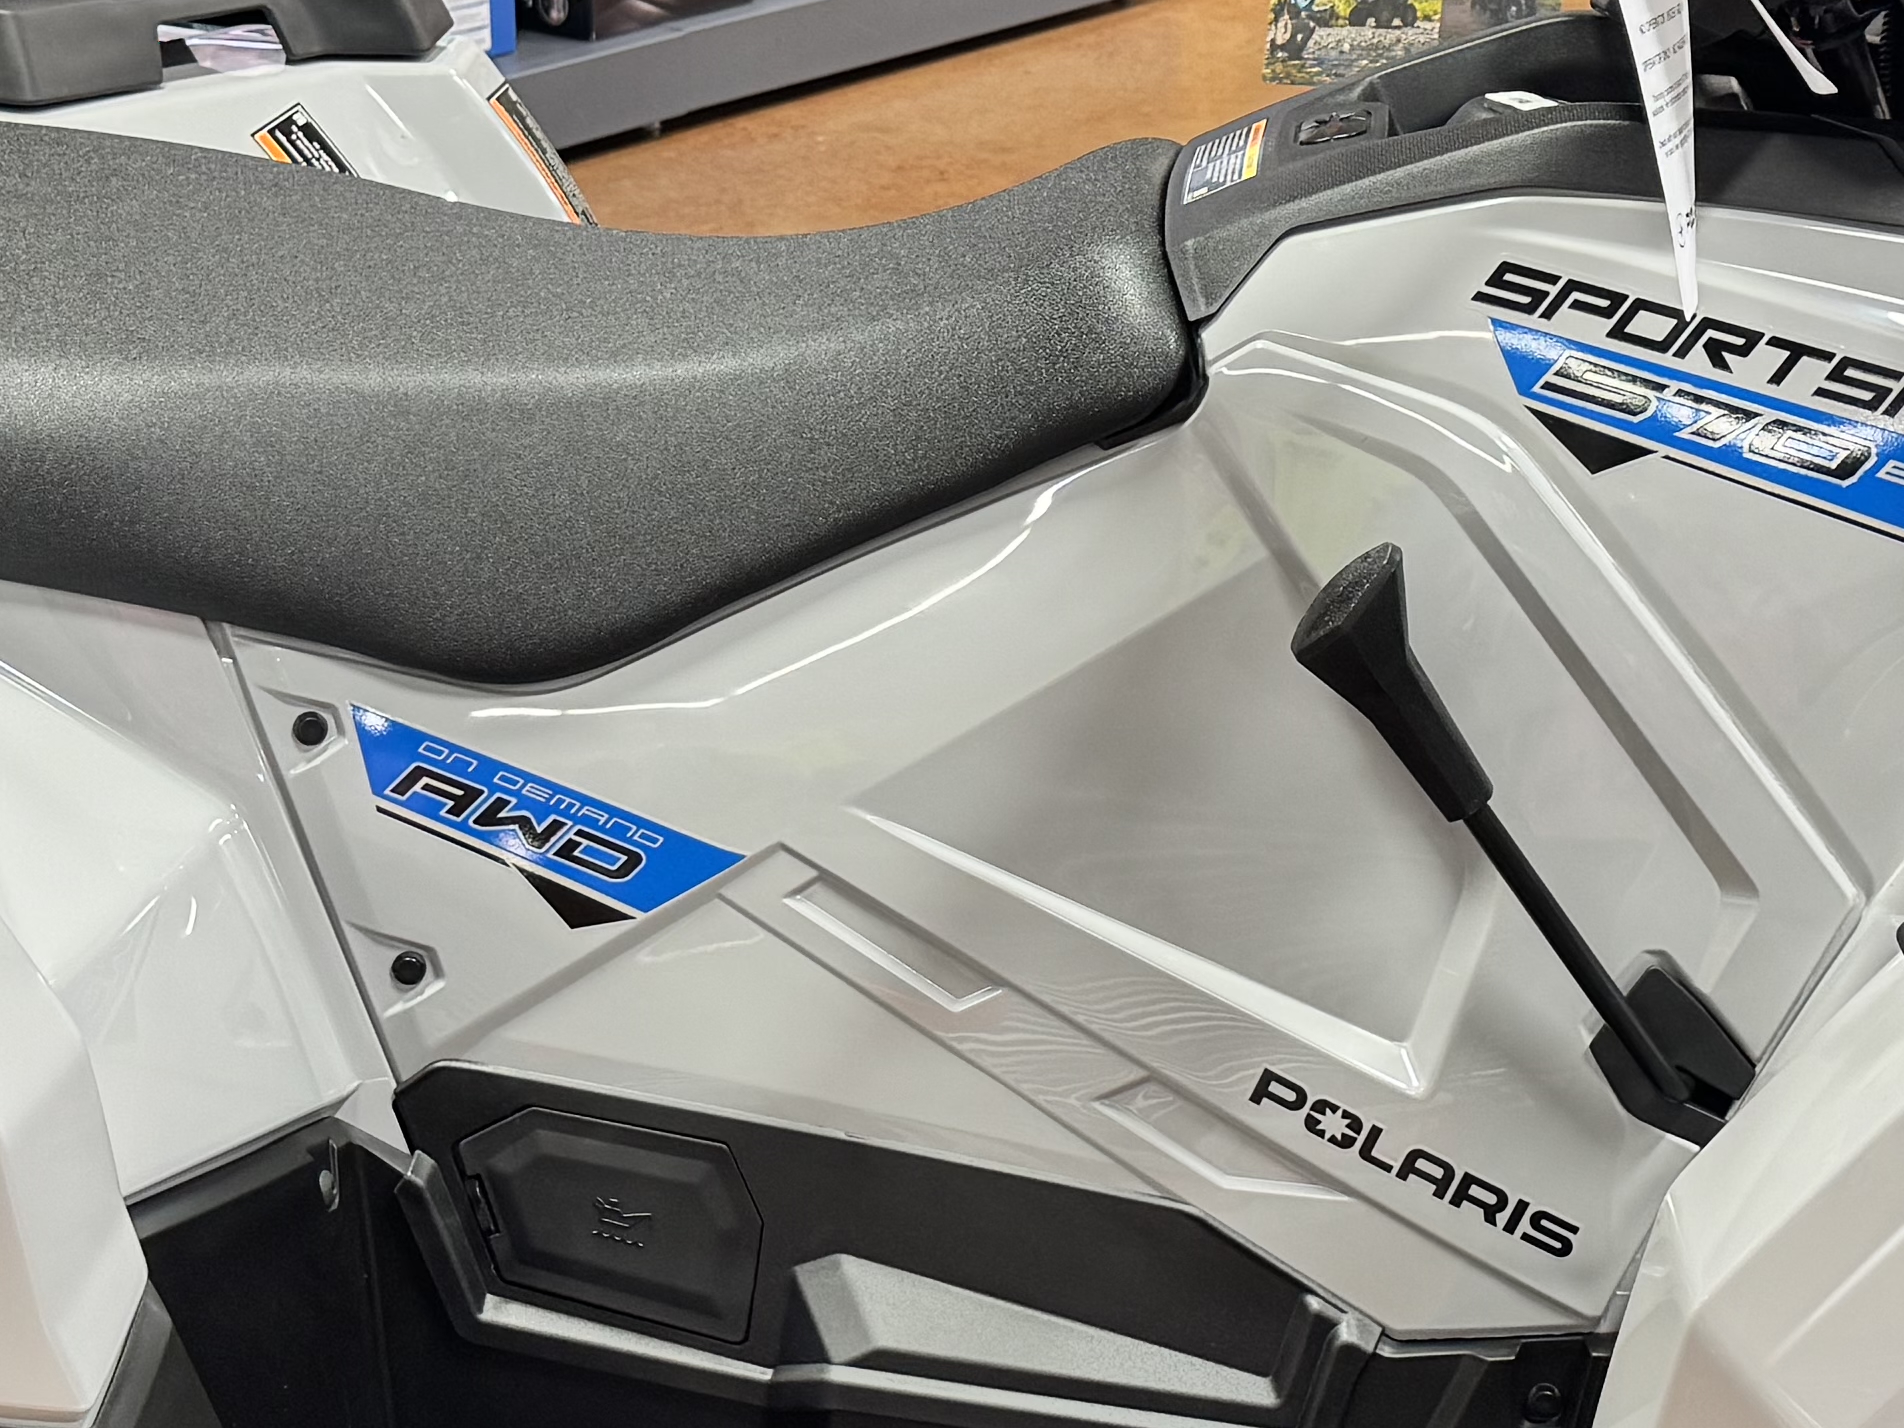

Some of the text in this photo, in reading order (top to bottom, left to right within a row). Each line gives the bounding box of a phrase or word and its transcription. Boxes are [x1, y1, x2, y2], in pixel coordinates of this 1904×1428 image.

[1532, 349, 1878, 486] 570
[389, 762, 646, 883] AWD
[417, 741, 664, 850] ON DEMAND
[1247, 1066, 1580, 1259] POLARIS
